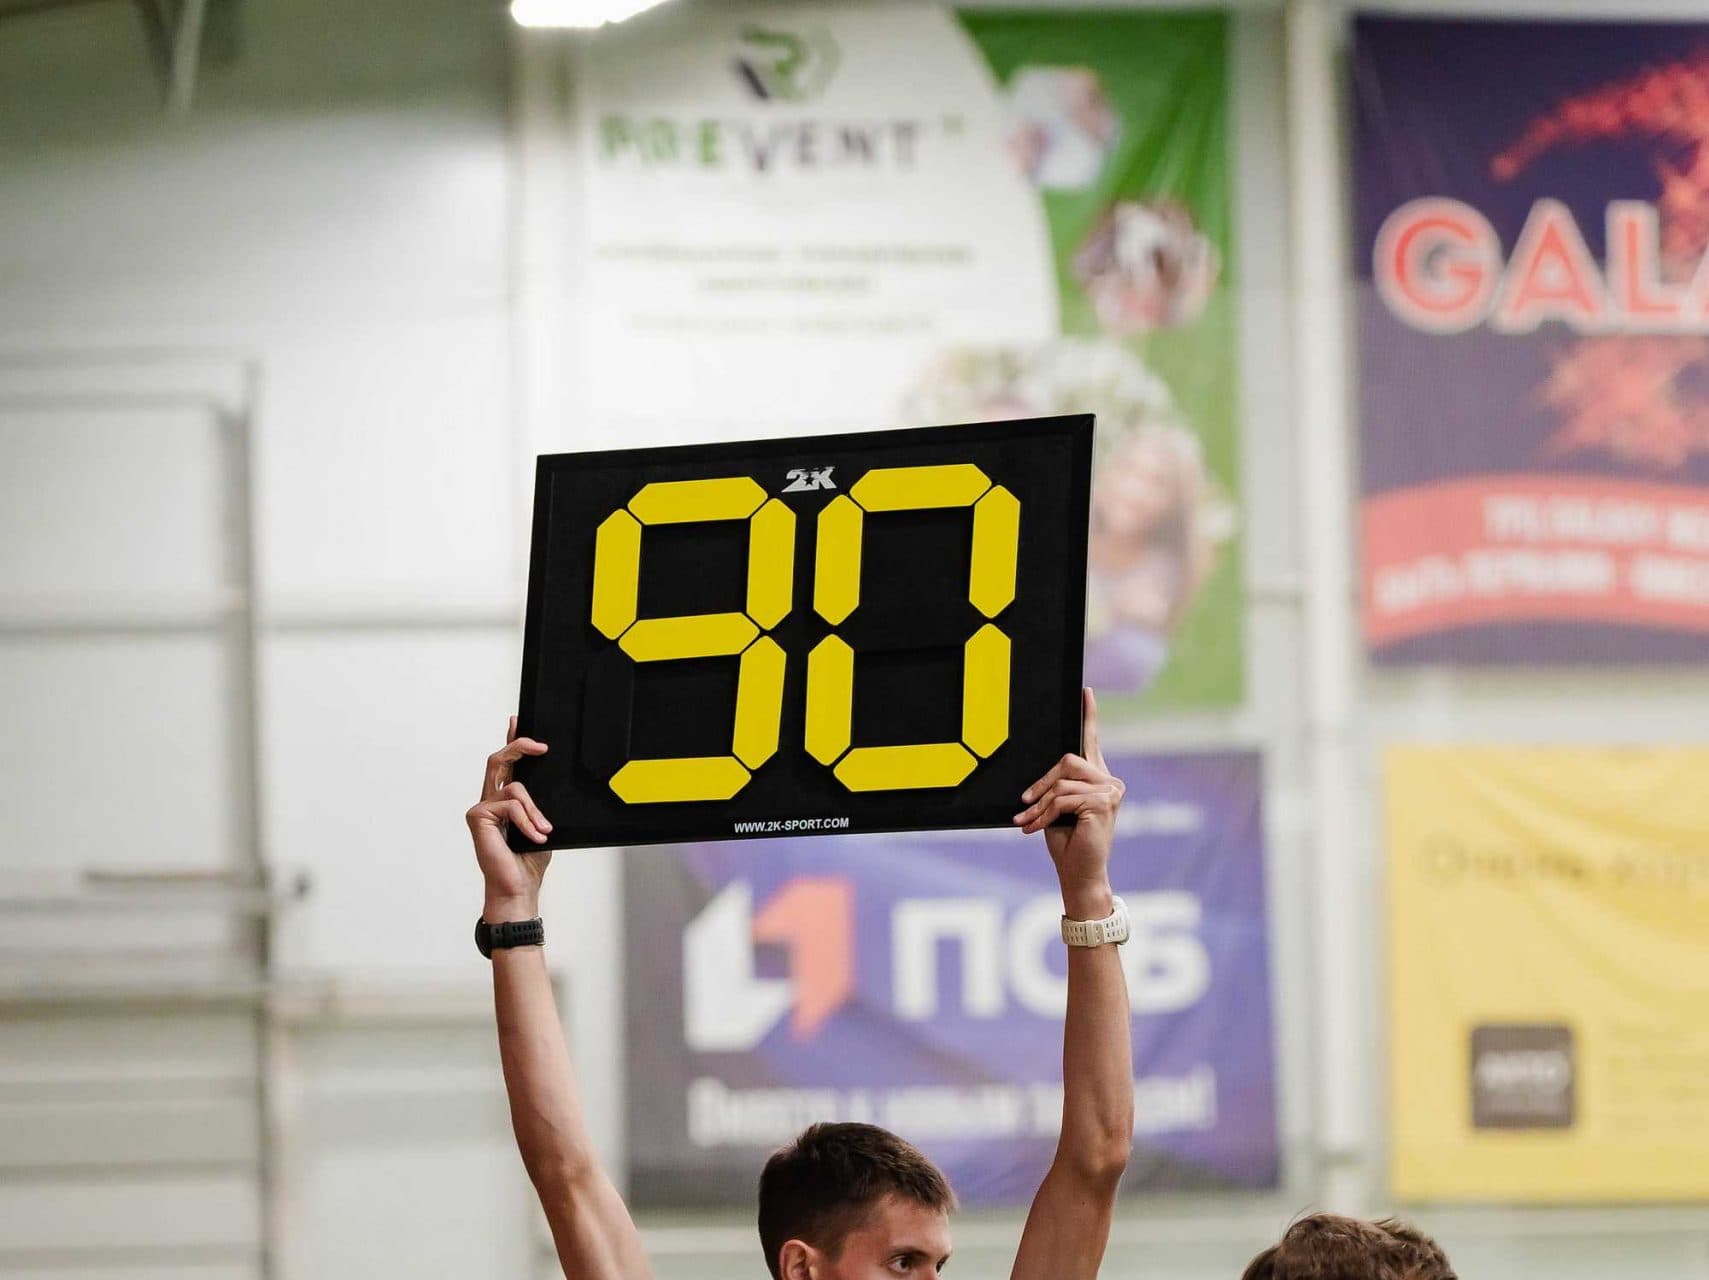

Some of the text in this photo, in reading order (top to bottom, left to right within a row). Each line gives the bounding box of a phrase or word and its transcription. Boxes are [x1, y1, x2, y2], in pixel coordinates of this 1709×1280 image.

[1373, 197, 1709, 333] GAL
[781, 466, 837, 493] 2K
[591, 463, 1021, 804] 90
[734, 817, 850, 833] WWW.2K-SPORT.COM
